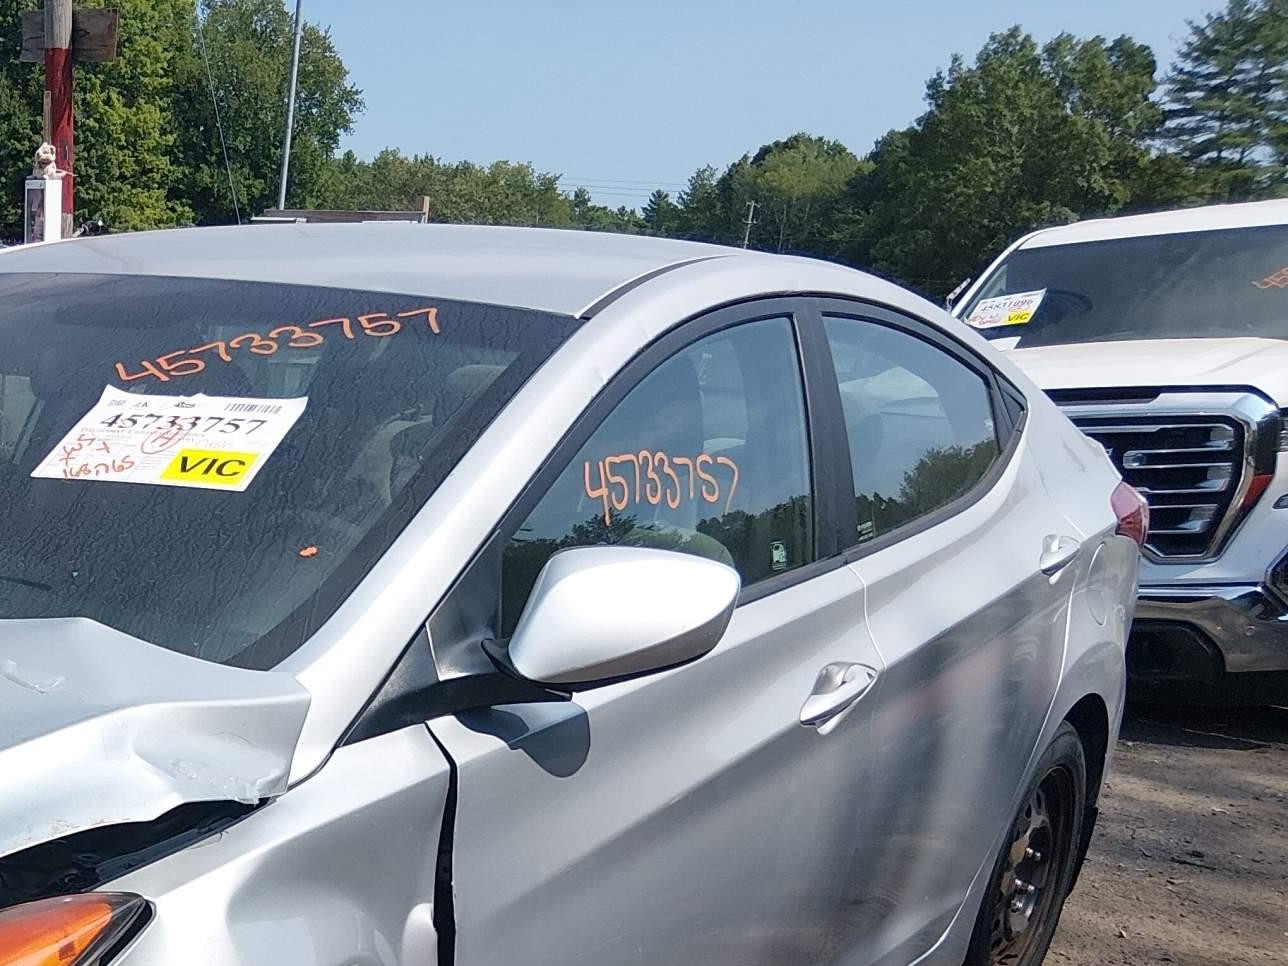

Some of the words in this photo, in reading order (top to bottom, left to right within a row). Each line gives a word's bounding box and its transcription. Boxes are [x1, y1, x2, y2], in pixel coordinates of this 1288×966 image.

[114, 307, 441, 382] 45733757
[100, 412, 269, 435] 45733757
[180, 456, 246, 477] VIC
[584, 450, 739, 526] 45733757
